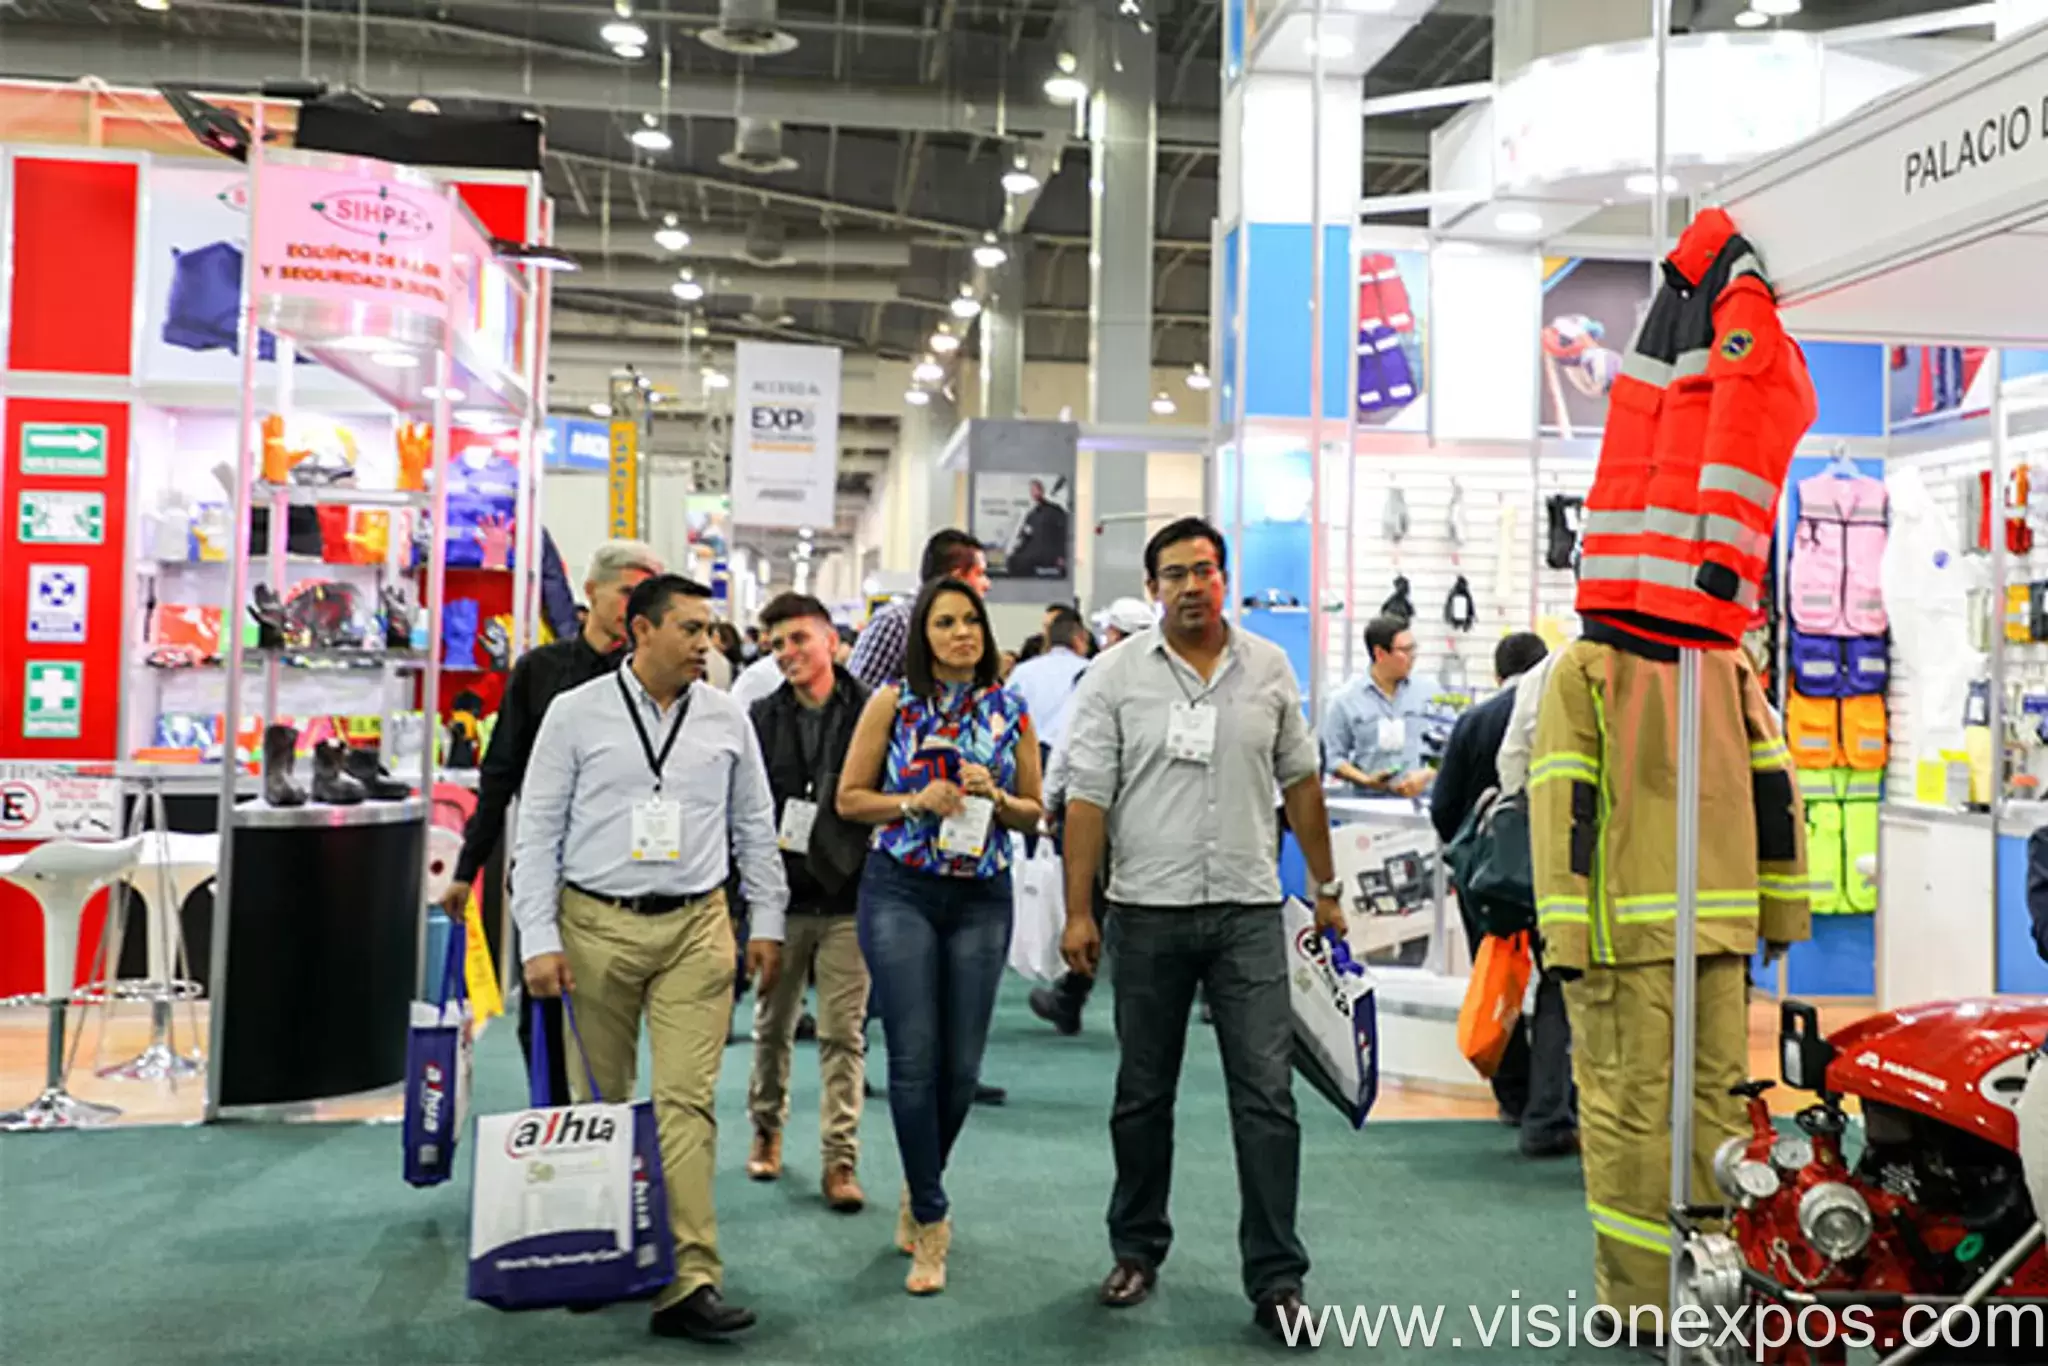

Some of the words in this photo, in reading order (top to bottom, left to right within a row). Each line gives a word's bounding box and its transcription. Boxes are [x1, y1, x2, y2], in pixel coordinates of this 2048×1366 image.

[1905, 106, 2031, 195] PALACIO
[335, 199, 424, 231] SIHPA
[751, 405, 815, 431] EXPO
